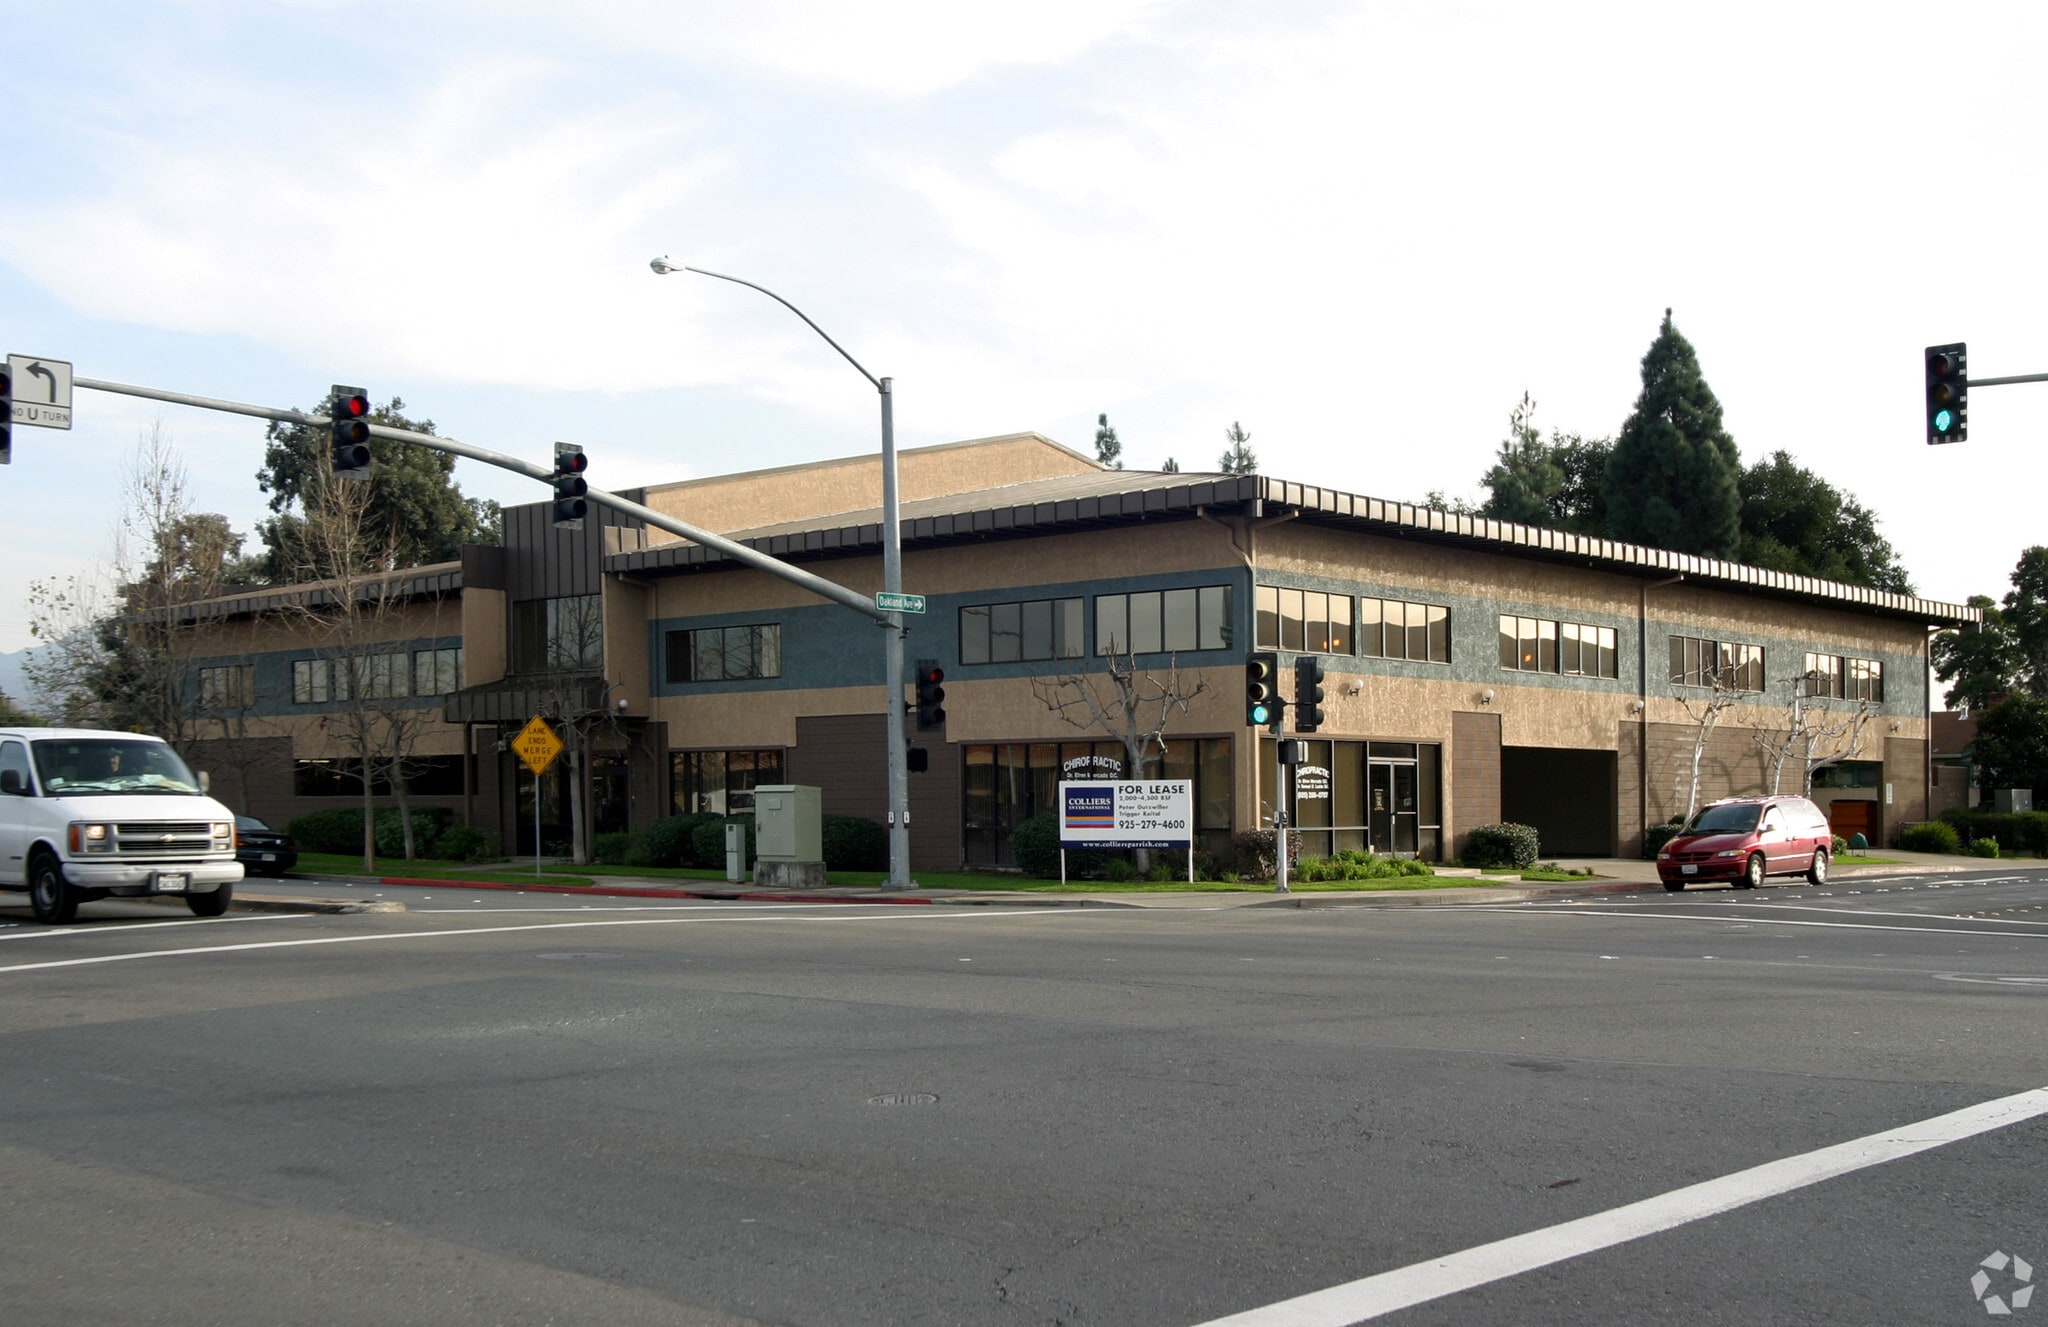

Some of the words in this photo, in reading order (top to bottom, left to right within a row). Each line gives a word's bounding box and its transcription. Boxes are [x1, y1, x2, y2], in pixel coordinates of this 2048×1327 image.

[28, 408, 38, 420] U
[43, 411, 70, 422] TURN
[879, 596, 902, 608] Oakland
[1119, 785, 1143, 794] FOR
[1150, 785, 1185, 794] LEASE
[1068, 798, 1111, 806] COLLIERS
[1119, 820, 1185, 829] 925-279-4600
